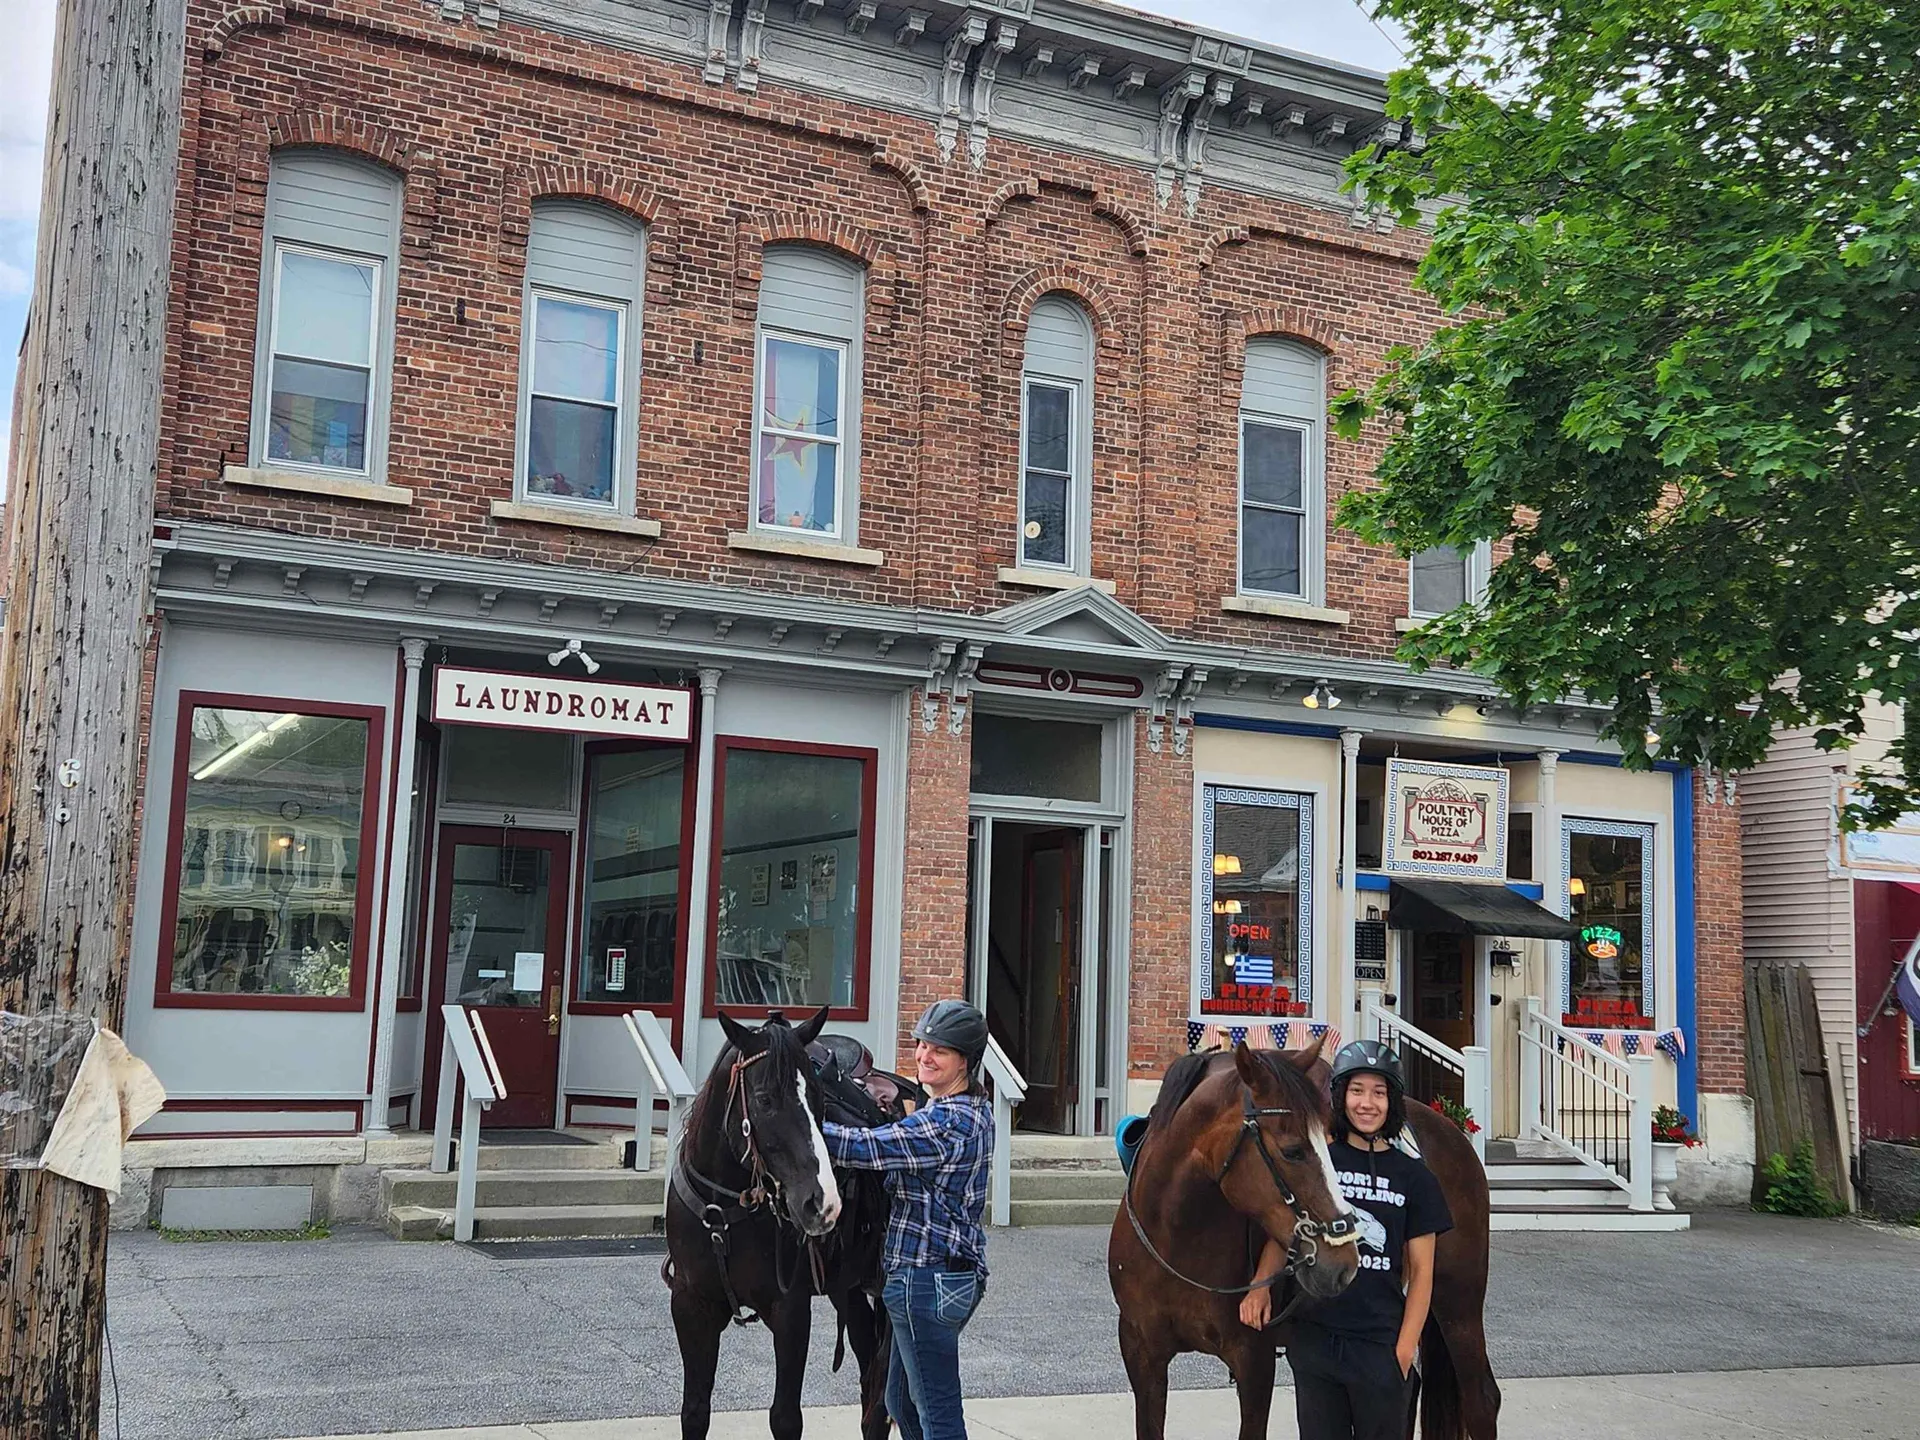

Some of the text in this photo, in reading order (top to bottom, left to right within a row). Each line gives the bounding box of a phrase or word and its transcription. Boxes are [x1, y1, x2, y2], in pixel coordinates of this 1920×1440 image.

[455, 683, 674, 725] LAUNDROMAT
[58, 758, 80, 788] 6
[55, 801, 71, 823] 6
[503, 813, 516, 825] 24
[1418, 803, 1475, 824] POULTNEY
[1422, 815, 1468, 829] HOUSE OF
[1431, 826, 1460, 838] PIZZA
[1229, 923, 1272, 941] OPEN
[1582, 926, 1621, 945] PIZZA
[1493, 939, 1511, 951] 245
[1355, 967, 1384, 979] OPEN
[1221, 982, 1290, 1000] PIZZA
